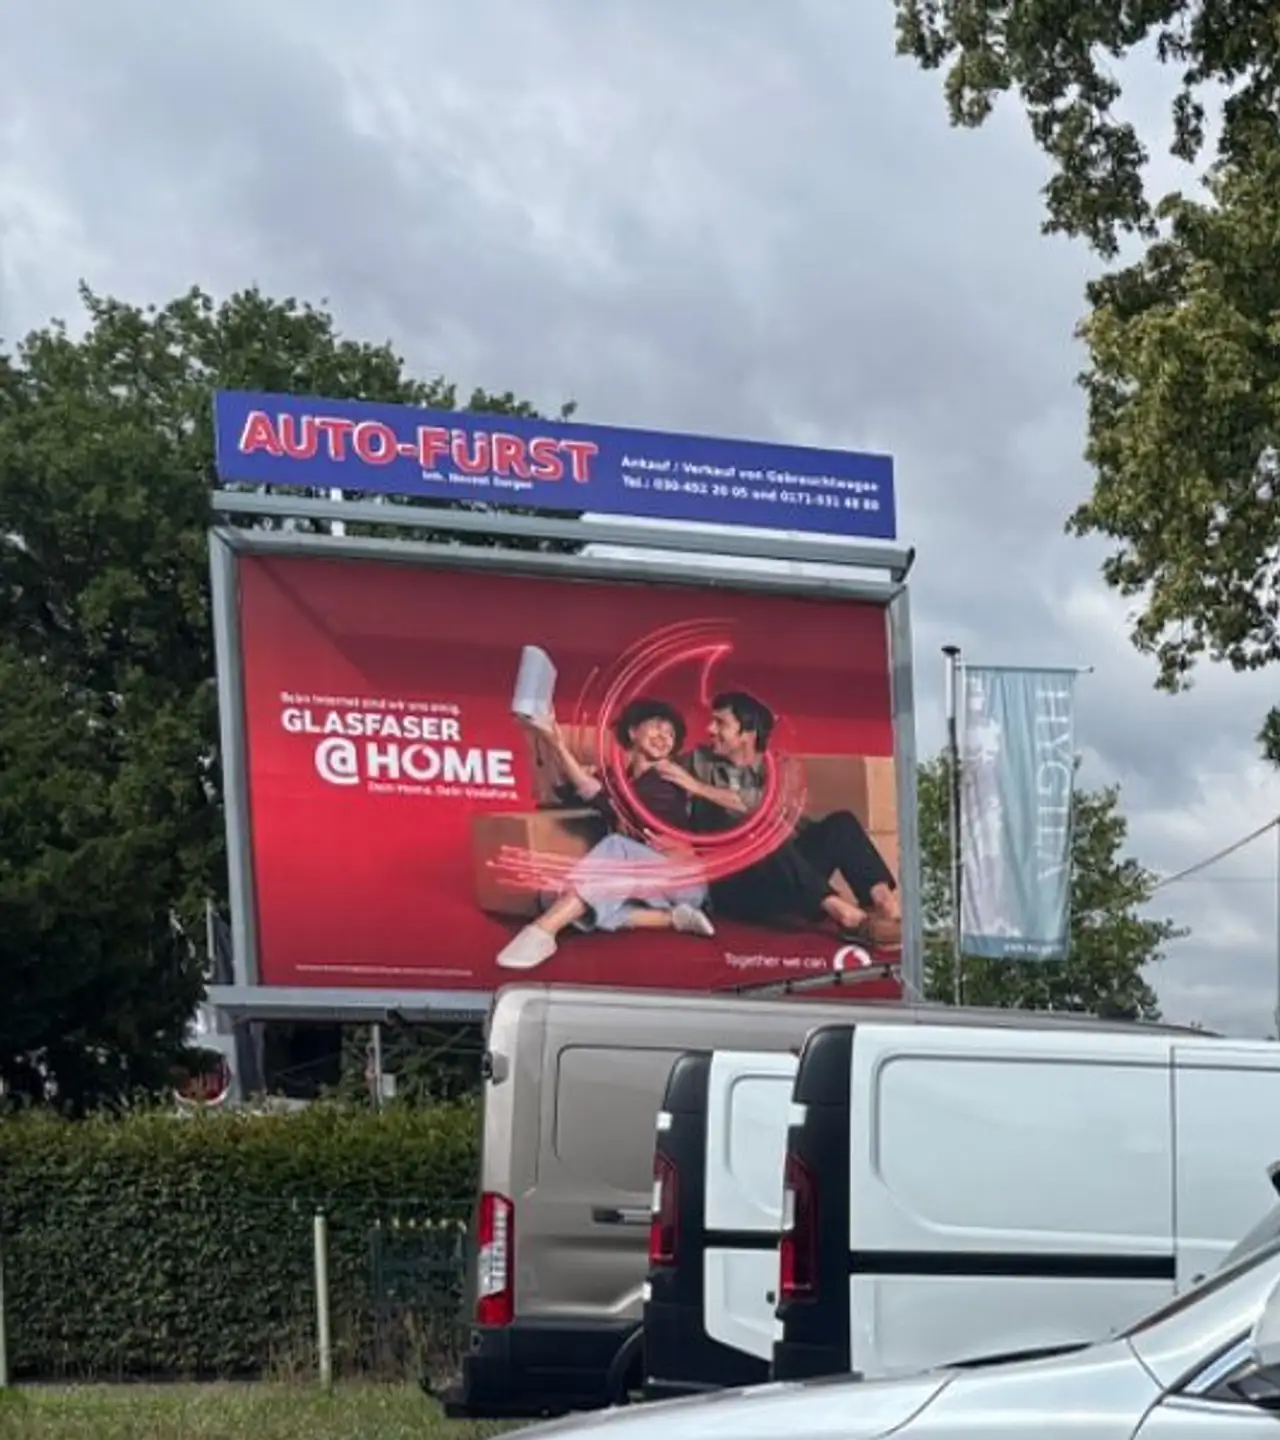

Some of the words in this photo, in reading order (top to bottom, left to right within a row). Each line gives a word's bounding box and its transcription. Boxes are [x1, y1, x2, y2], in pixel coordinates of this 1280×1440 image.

[239, 410, 599, 483] AUTO-FÜRST
[621, 454, 671, 472] Ankauf
[682, 462, 736, 477] Verkauf
[281, 707, 462, 742] GLASFASER
[314, 736, 516, 785] @HOME
[724, 951, 781, 969] Together
[803, 957, 827, 969] can
